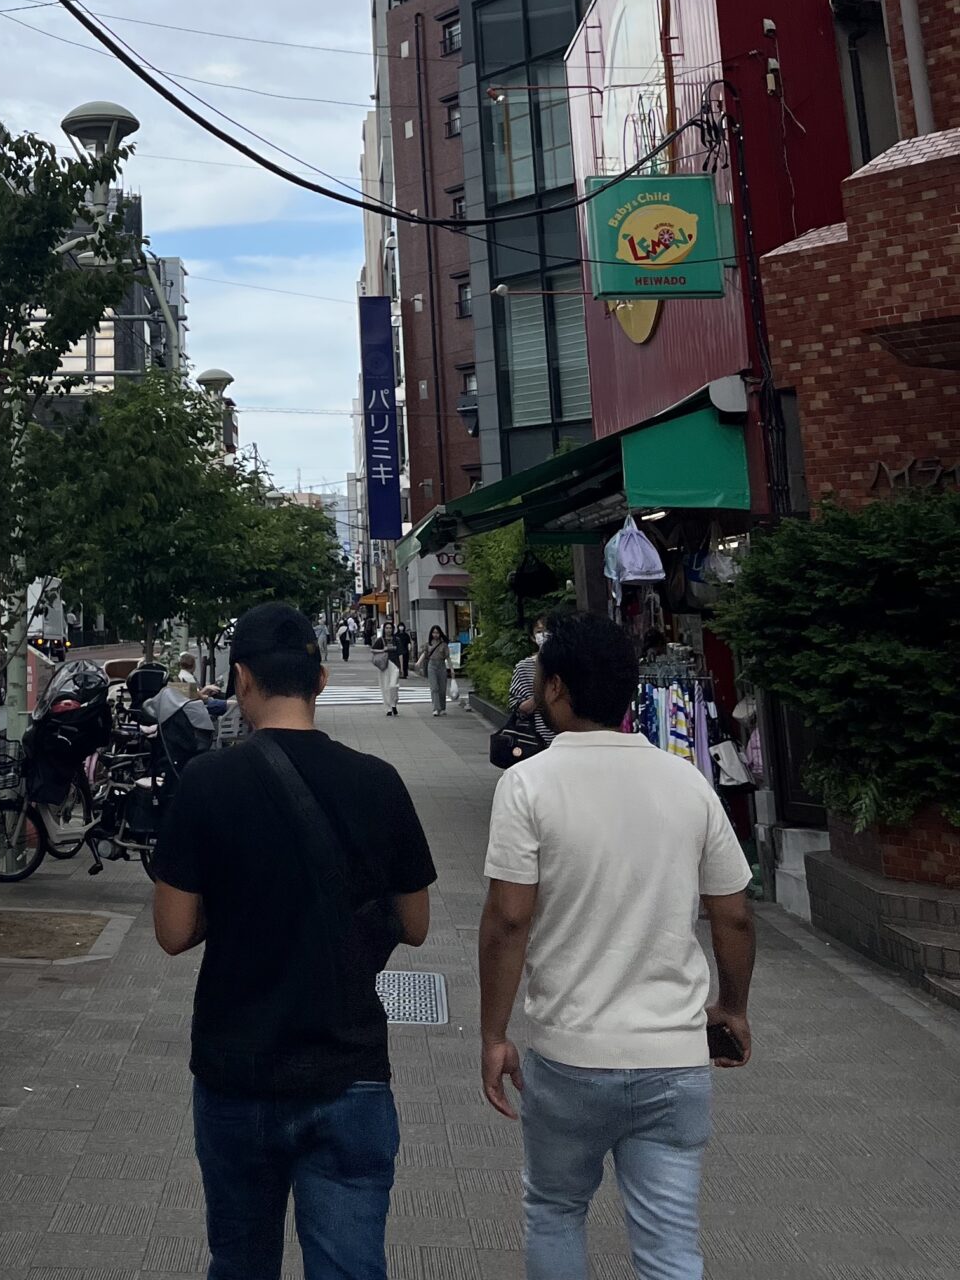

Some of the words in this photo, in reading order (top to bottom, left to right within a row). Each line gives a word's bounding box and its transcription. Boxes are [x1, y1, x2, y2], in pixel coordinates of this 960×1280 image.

[608, 202, 633, 228] Baby
[637, 191, 671, 202] Child
[635, 276, 687, 286] HEIWADO
[368, 388, 394, 486] パリミキ
